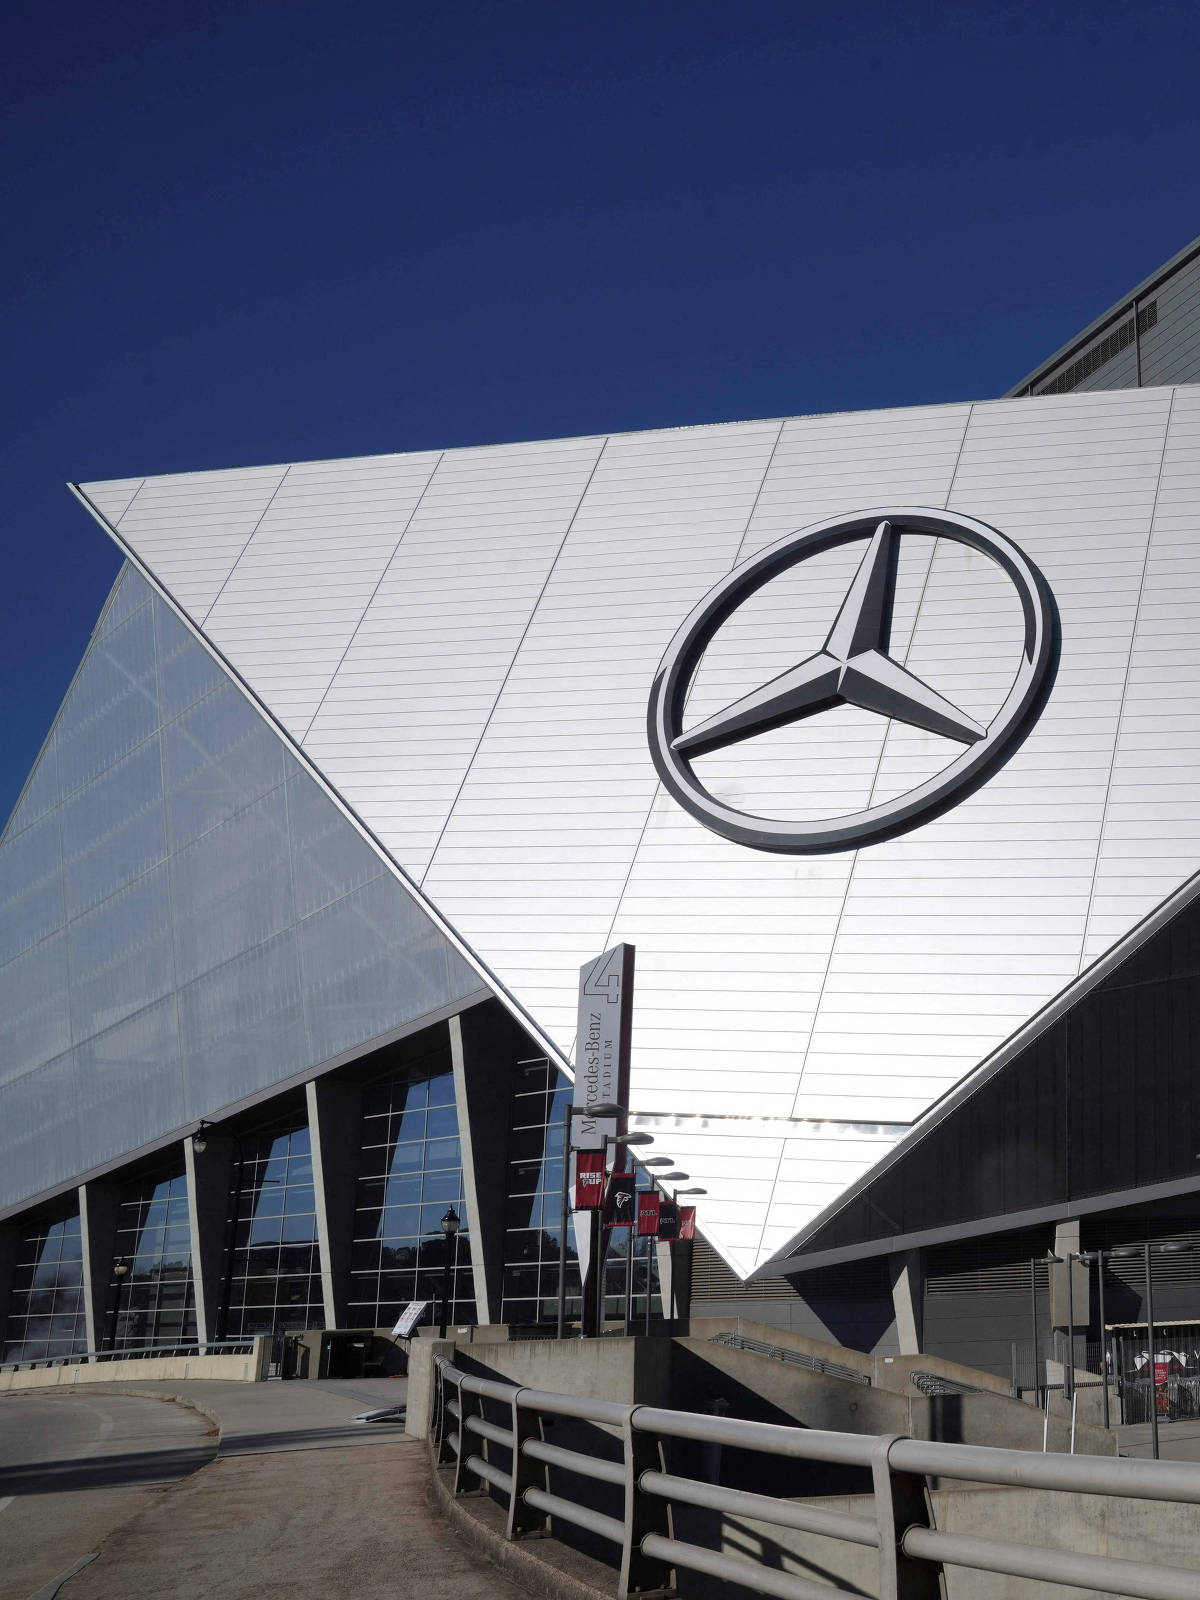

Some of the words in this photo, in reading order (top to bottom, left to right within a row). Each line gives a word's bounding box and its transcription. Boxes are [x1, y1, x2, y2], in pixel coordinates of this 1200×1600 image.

[583, 948, 620, 1004] 4
[581, 1013, 601, 1135] Mrcedes-Benz
[602, 1039, 613, 1099] TADIUM
[579, 1171, 602, 1179] RISE
